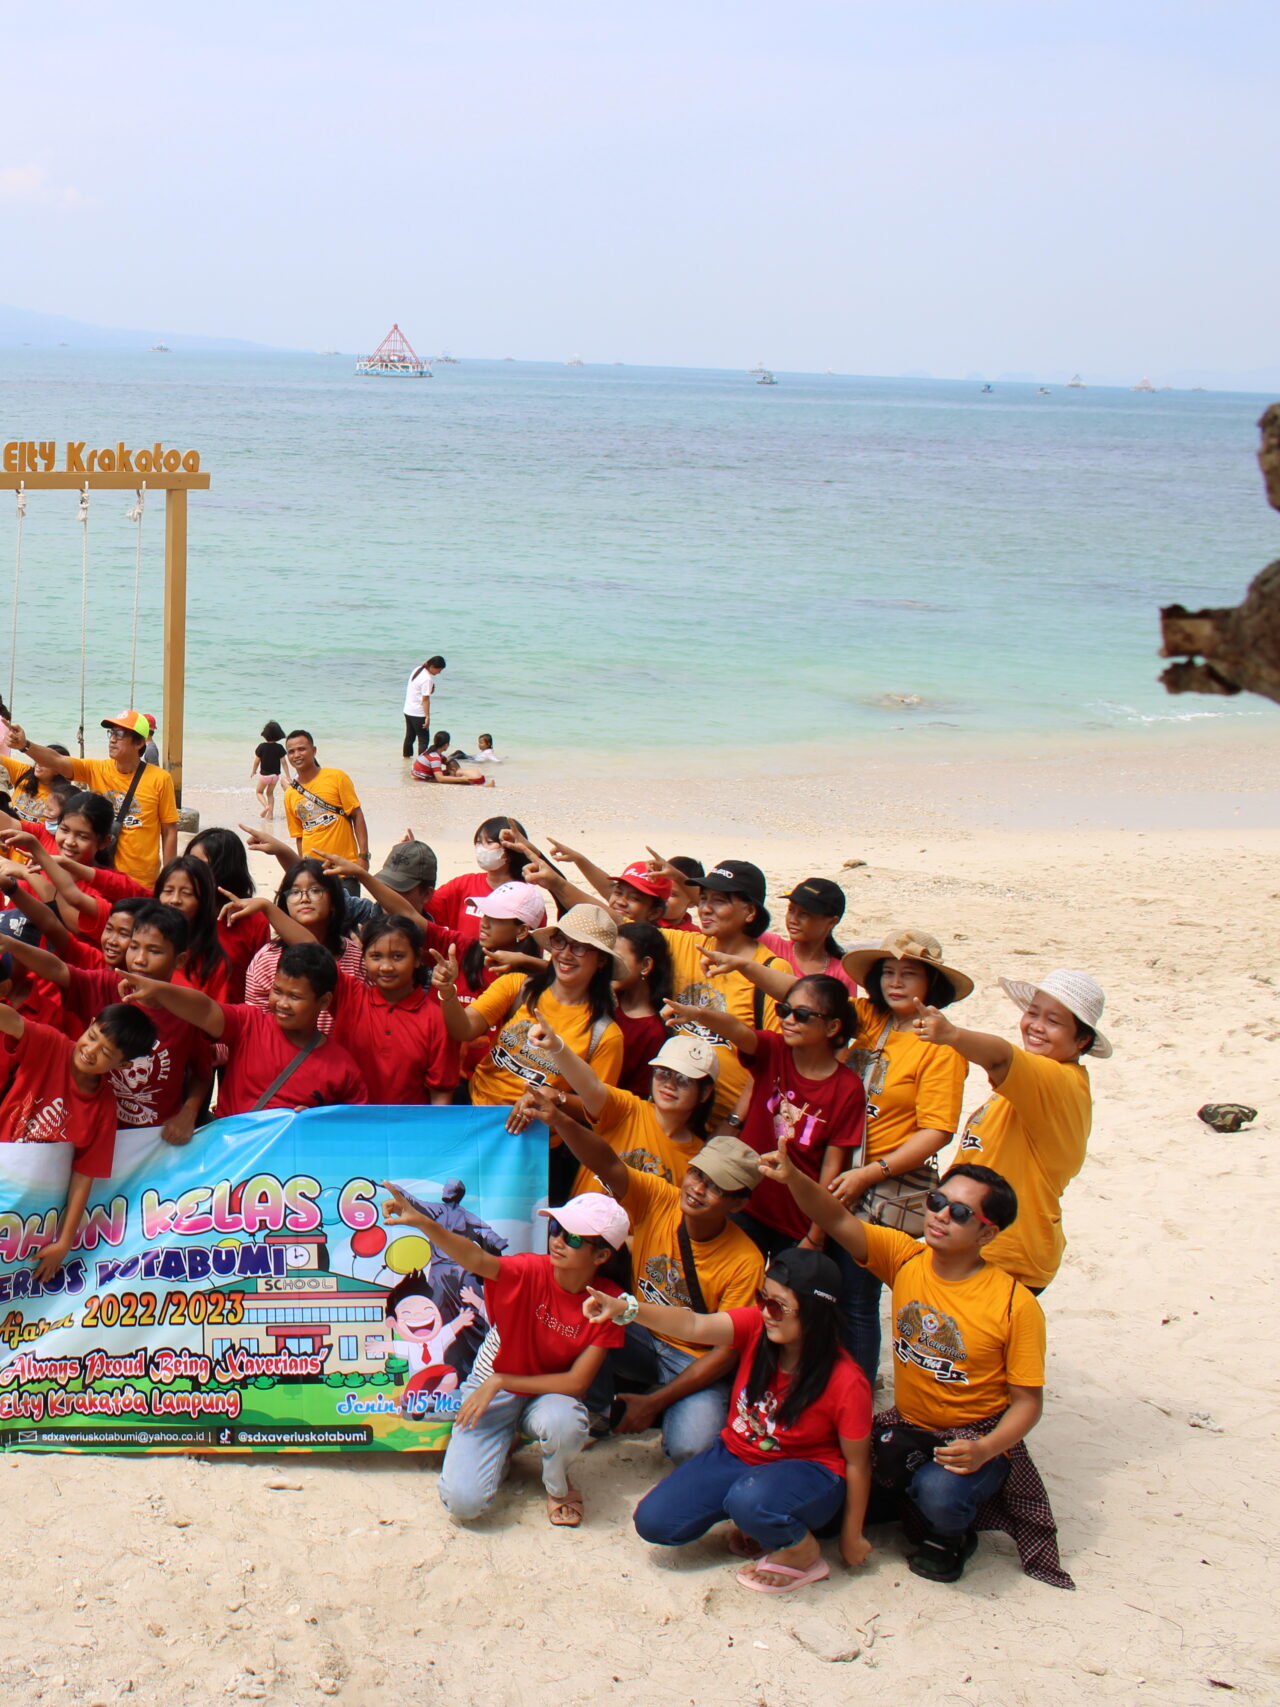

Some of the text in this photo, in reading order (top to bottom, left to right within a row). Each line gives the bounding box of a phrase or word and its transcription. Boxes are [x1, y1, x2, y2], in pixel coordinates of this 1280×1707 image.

[66, 441, 201, 473] Krakatoa
[141, 1172, 323, 1241] KELAS
[337, 1176, 379, 1232] 6
[96, 1241, 288, 1291] KOTABUMI
[264, 1278, 334, 1291] SCHOOL
[81, 1290, 246, 1329] 2022/2023
[84, 1348, 146, 1385] Proud
[149, 1348, 211, 1385] Being
[922, 1358, 942, 1371] 1964
[46, 1385, 149, 1420] Krakatoa
[150, 1387, 242, 1420] Lampung
[336, 1391, 402, 1415] Senin,
[406, 1389, 429, 1413] 15
[237, 1430, 368, 1444] @sdxaveriuskotabumi
